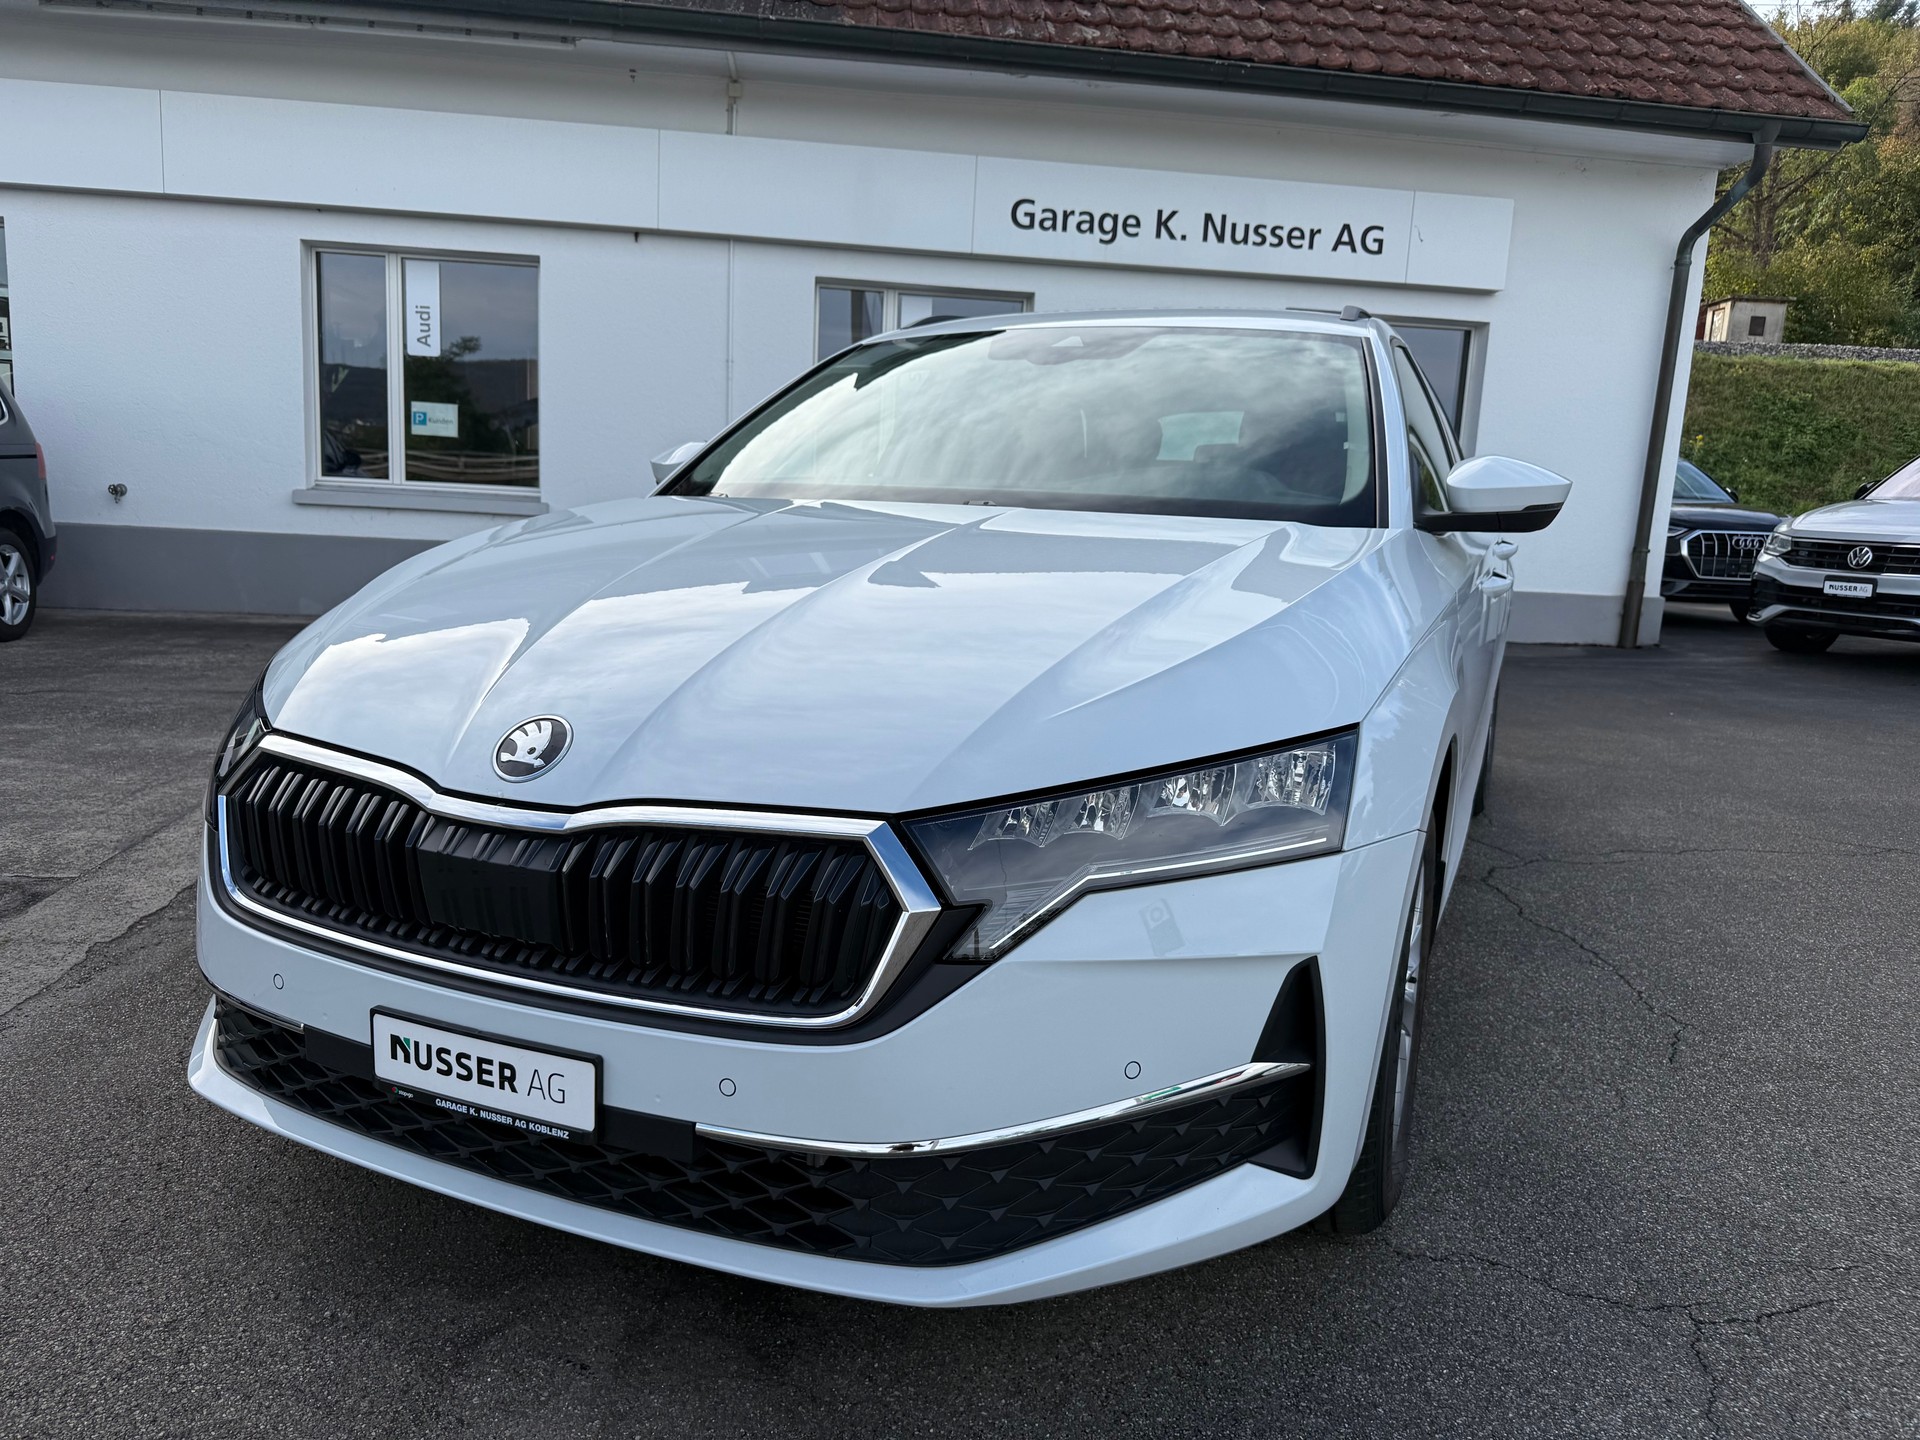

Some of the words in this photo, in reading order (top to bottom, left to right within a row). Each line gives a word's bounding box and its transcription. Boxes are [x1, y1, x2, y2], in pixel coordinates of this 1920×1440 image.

[1010, 198, 1141, 245] Garage
[1155, 209, 1187, 241] K.
[1201, 213, 1321, 250] Nusser
[1331, 223, 1385, 255] AG
[415, 304, 431, 348] Audi
[416, 413, 424, 424] P
[1829, 584, 1858, 592] NUSSER
[390, 1033, 518, 1093] NUSSER
[527, 1068, 566, 1104] AG
[435, 1098, 468, 1114] GARAGE
[469, 1106, 479, 1116] K.
[480, 1110, 513, 1125] NUSSER
[514, 1118, 527, 1129] AG
[529, 1122, 570, 1139] KOBLENZ
